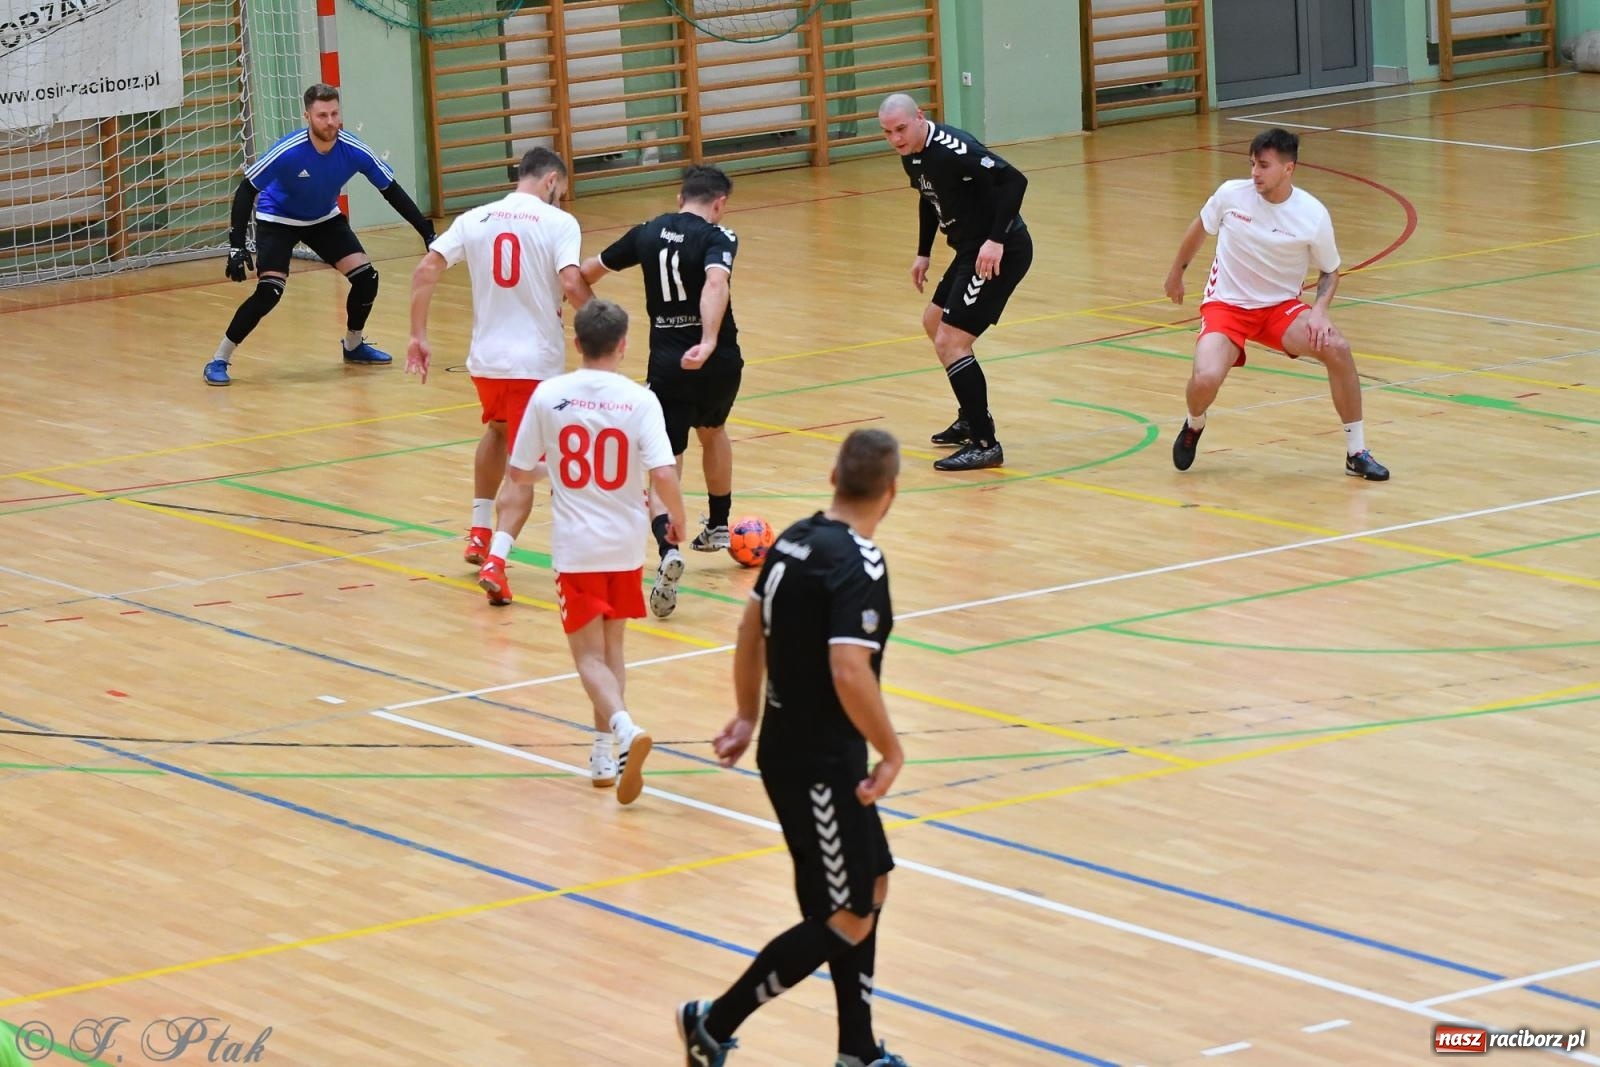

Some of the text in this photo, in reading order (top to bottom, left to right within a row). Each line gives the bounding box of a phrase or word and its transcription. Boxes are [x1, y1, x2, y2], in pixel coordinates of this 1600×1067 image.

[492, 232, 521, 288] 0
[659, 247, 687, 302] 11
[570, 398, 596, 410] PRD
[558, 424, 629, 491] 80
